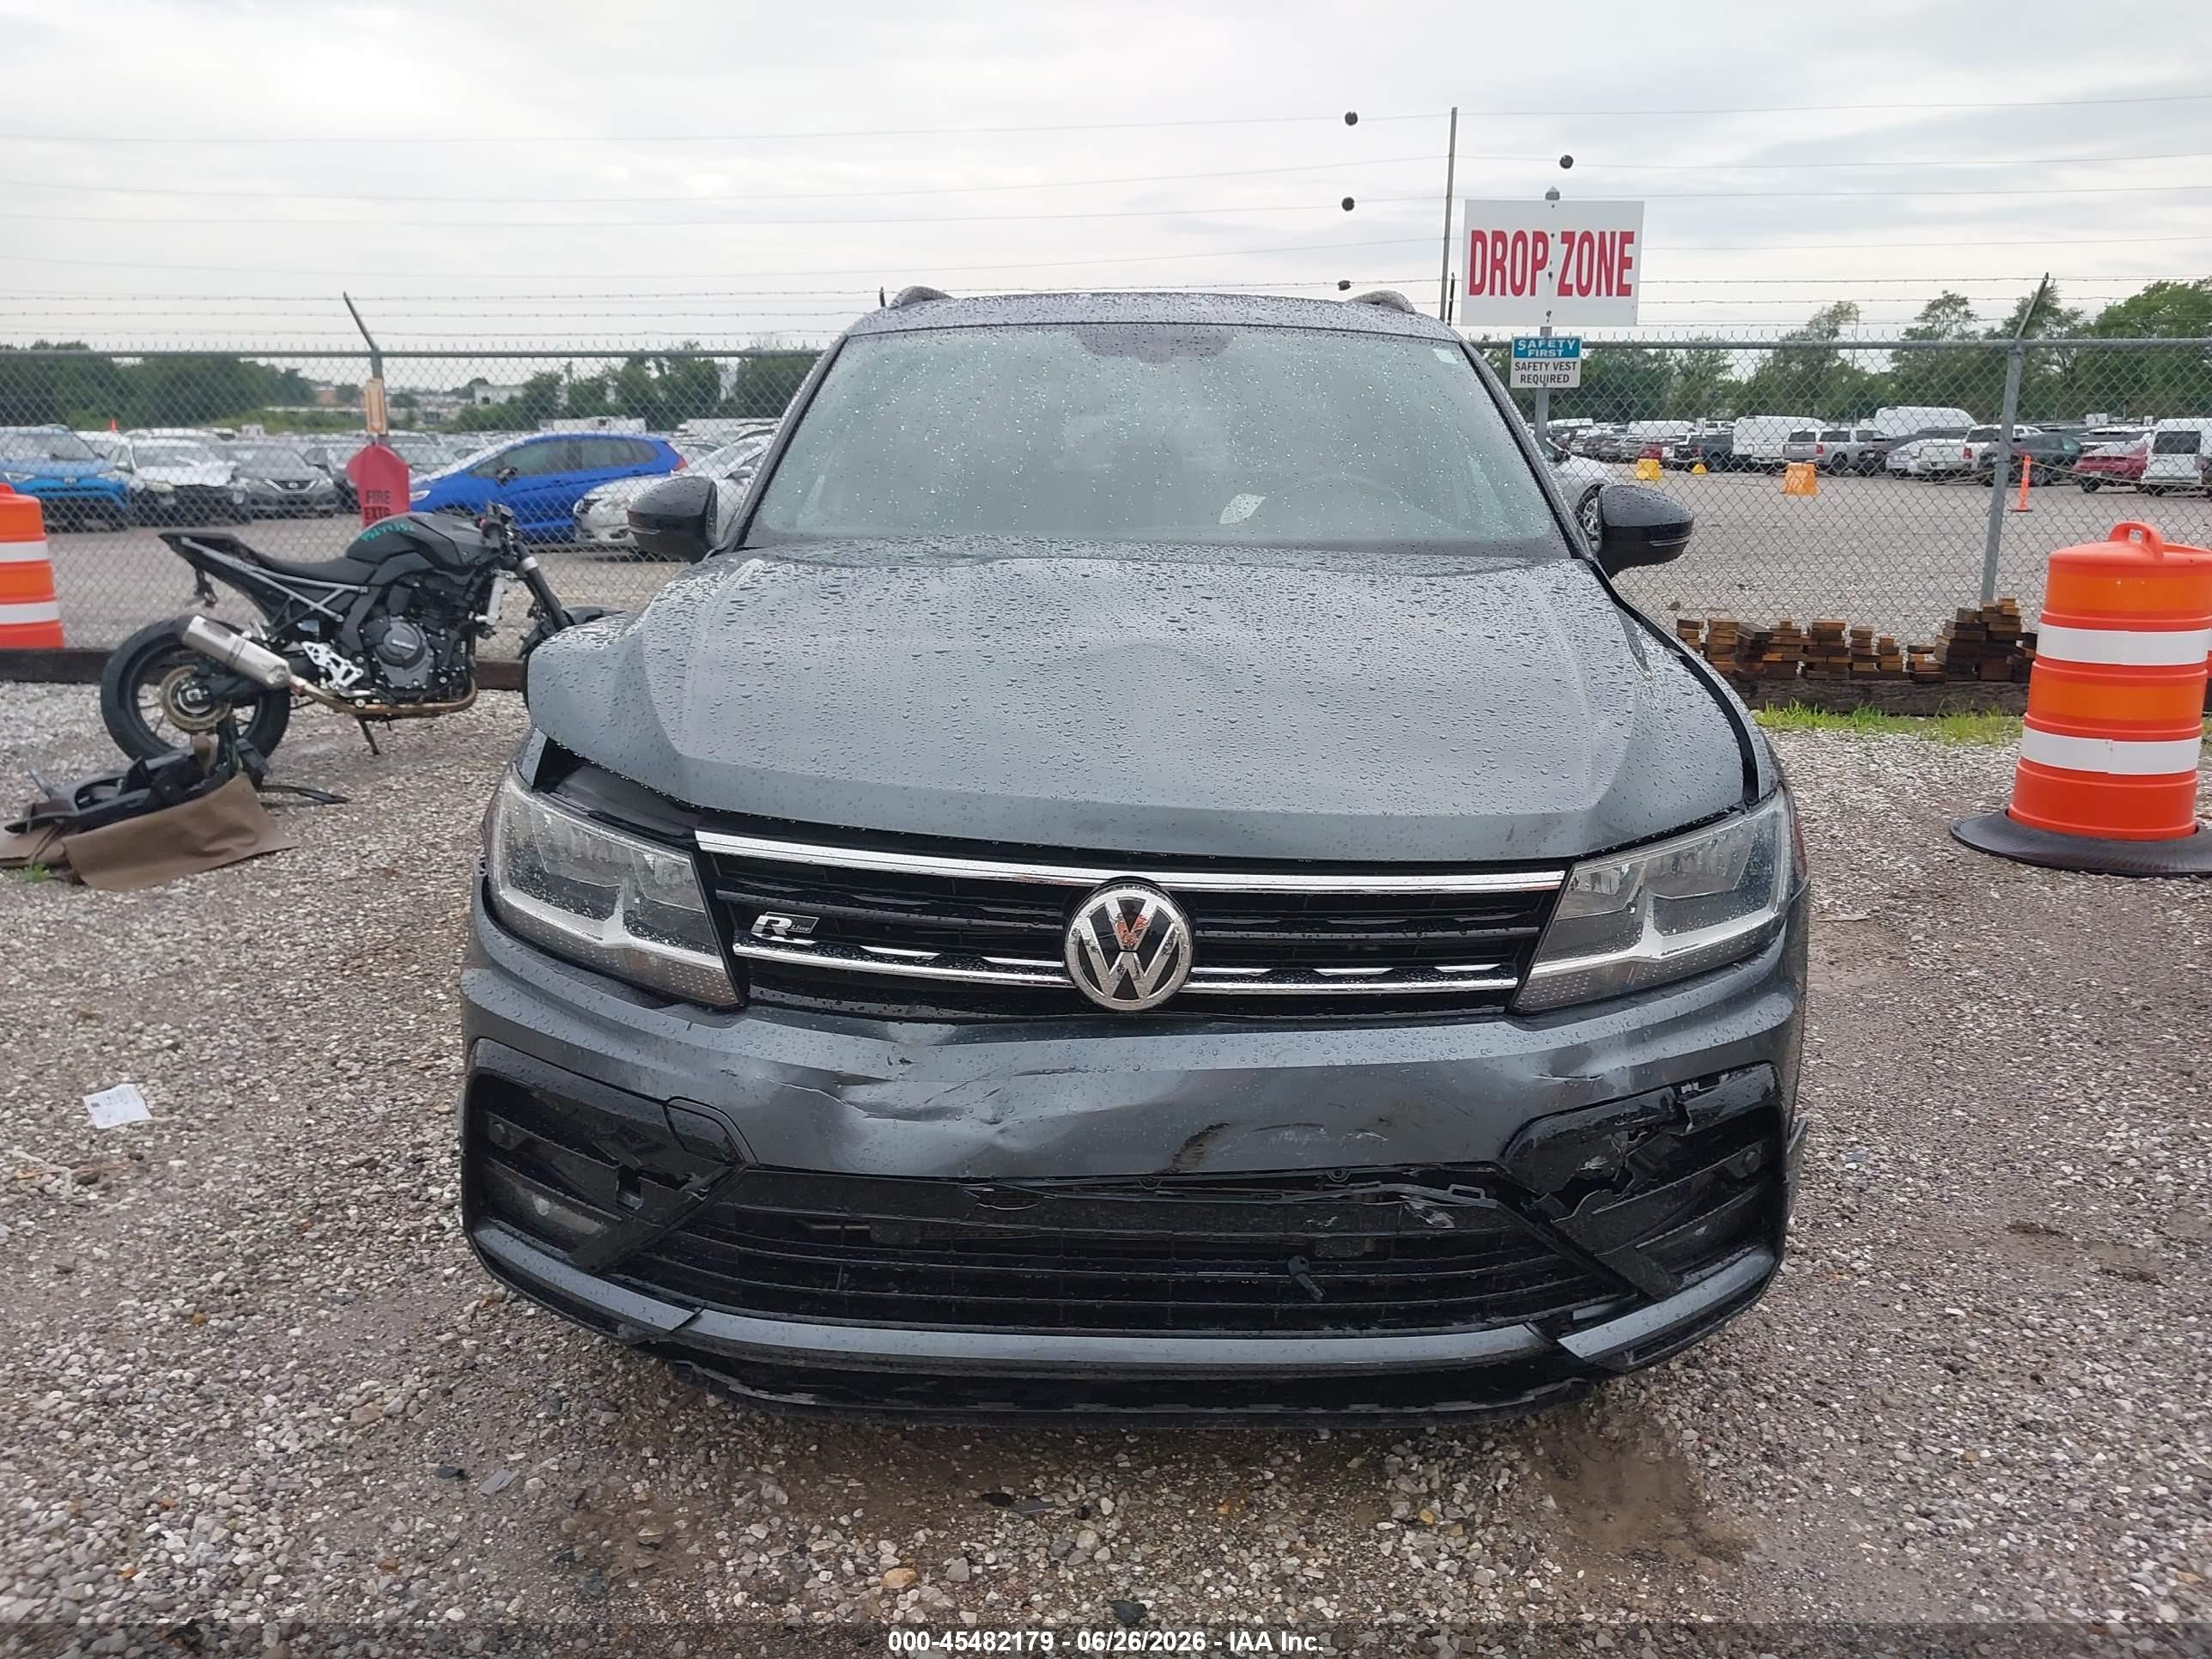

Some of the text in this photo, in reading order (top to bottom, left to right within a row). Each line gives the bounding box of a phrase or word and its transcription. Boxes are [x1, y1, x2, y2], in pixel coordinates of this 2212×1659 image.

[1469, 230, 1635, 296] DROP ZONE
[1518, 339, 1576, 350] SAFETY
[1527, 349, 1565, 357] FIRST
[1515, 361, 1577, 372] SAFETY VEST
[1520, 374, 1570, 385] REQUIRED
[365, 489, 391, 504] FIRE
